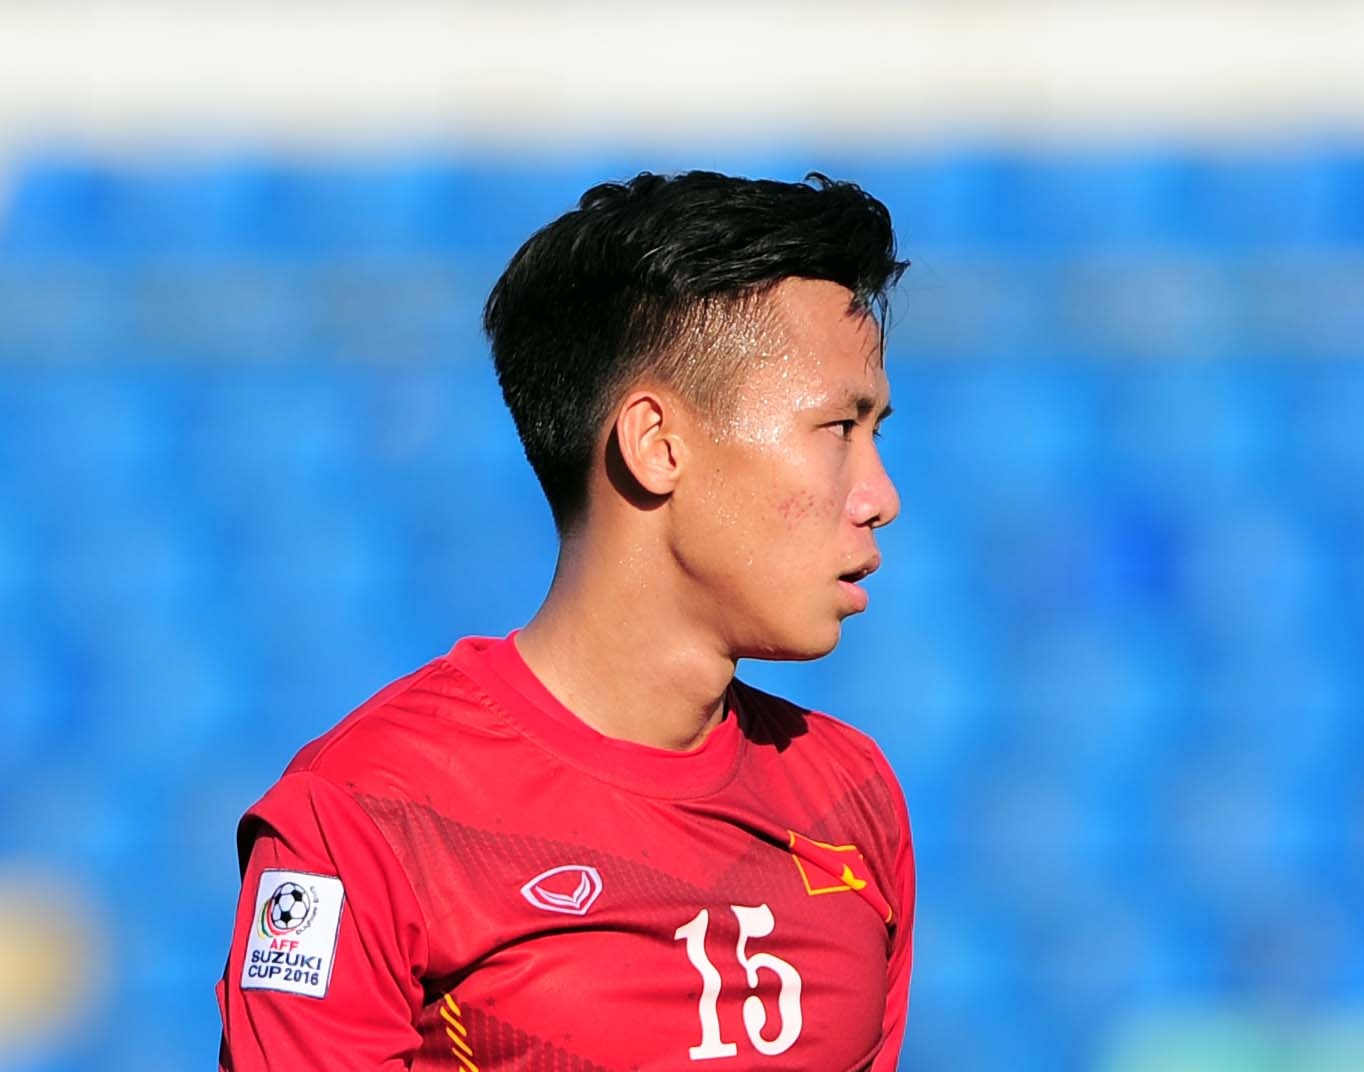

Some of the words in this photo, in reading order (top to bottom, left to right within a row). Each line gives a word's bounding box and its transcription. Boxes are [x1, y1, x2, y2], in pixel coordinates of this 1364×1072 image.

[270, 938, 299, 951] AFF
[251, 950, 322, 970] SUZUKI
[248, 965, 282, 979] CUP
[283, 968, 319, 986] 2016
[674, 904, 802, 1060] 15
